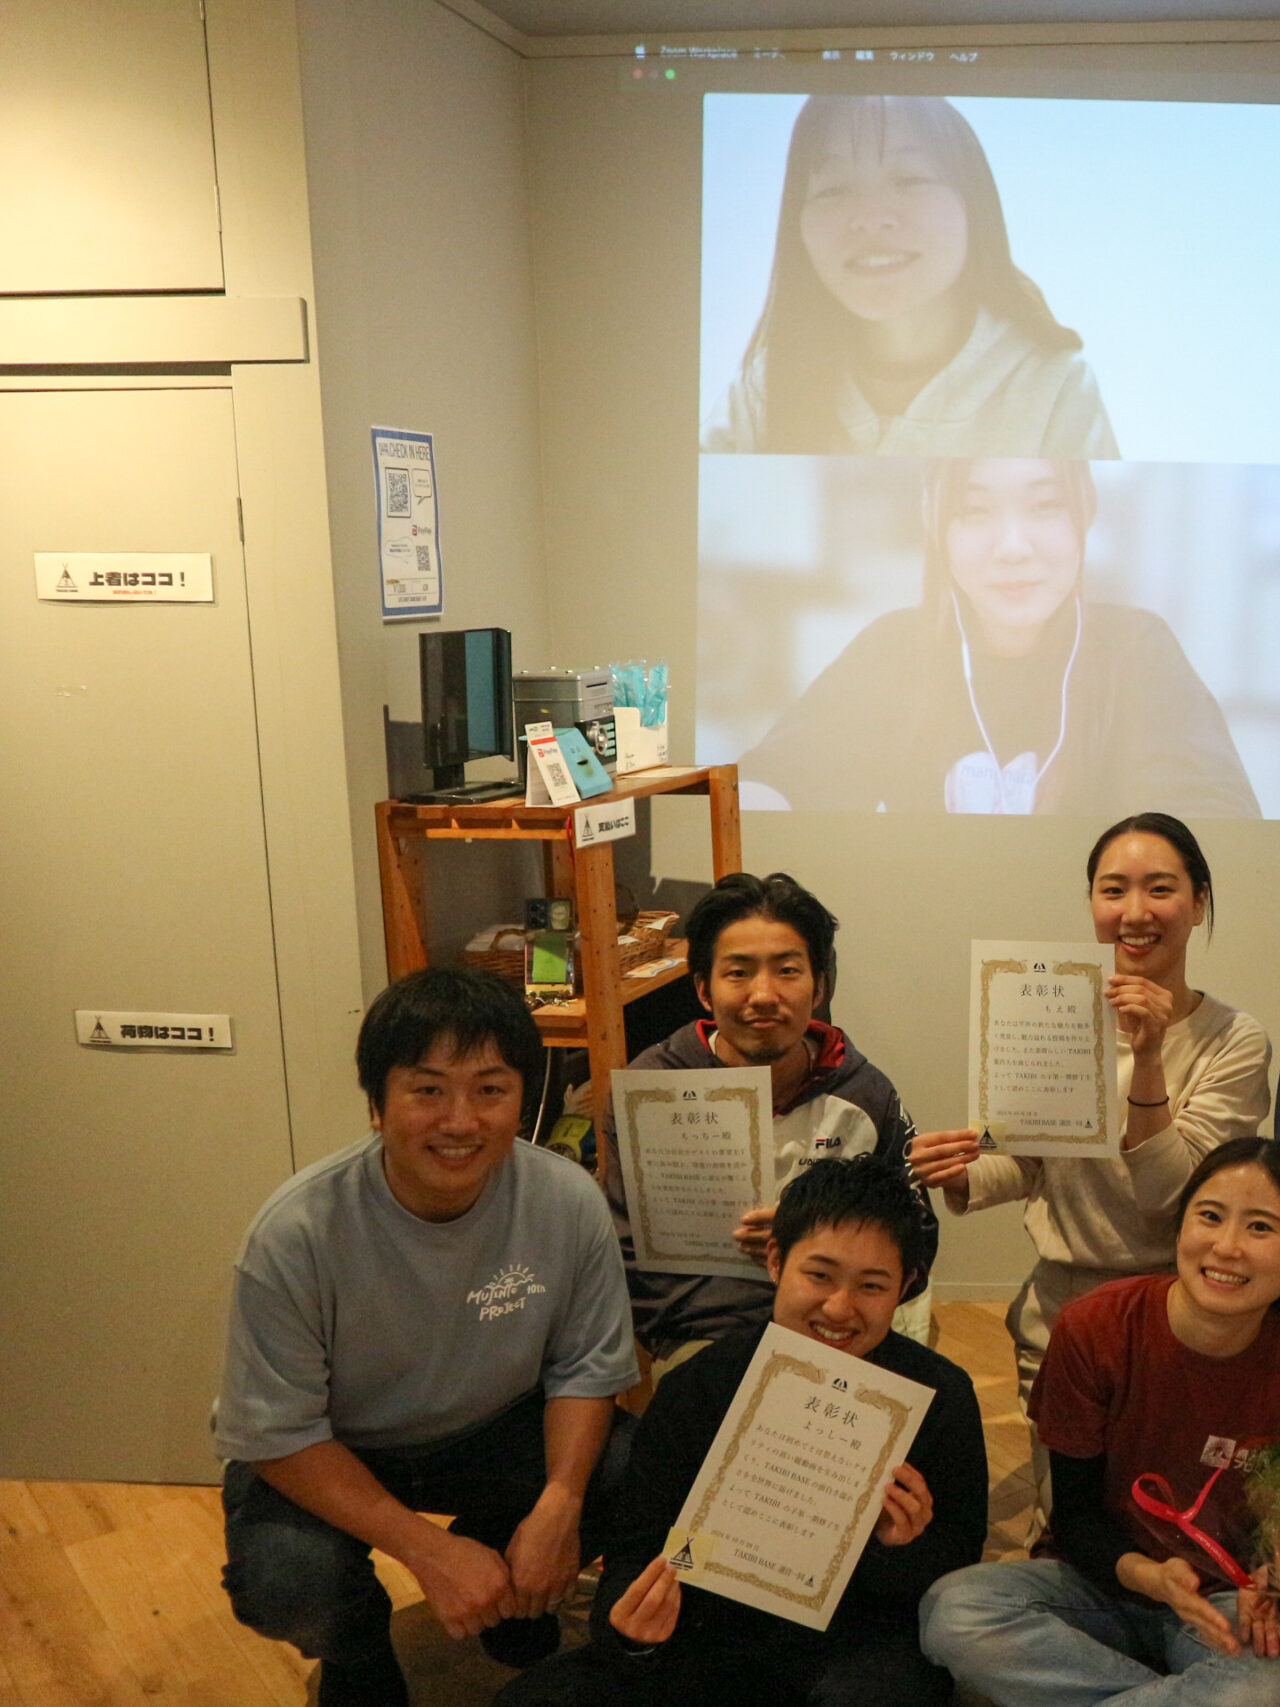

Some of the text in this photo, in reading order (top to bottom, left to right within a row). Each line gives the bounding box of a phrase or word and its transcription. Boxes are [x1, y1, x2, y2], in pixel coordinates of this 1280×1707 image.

[889, 51, 935, 62] ウィンドウ
[949, 52, 978, 62] ヘルプ
[89, 571, 186, 587] 上着はココ！
[1020, 983, 1064, 997] 表彰状
[120, 1024, 215, 1042] 荷物はココ！
[670, 1112, 719, 1125] 表彰状
[815, 1136, 842, 1149] FILA
[803, 1396, 861, 1428] 表彰状
[802, 1419, 863, 1451] よっしー殿
[762, 1461, 791, 1478] TAKIBI
[789, 1471, 811, 1486] BASE
[752, 1492, 781, 1509] TAKIBI
[732, 1548, 759, 1564] TAKIBI
[756, 1557, 777, 1570] BASE
